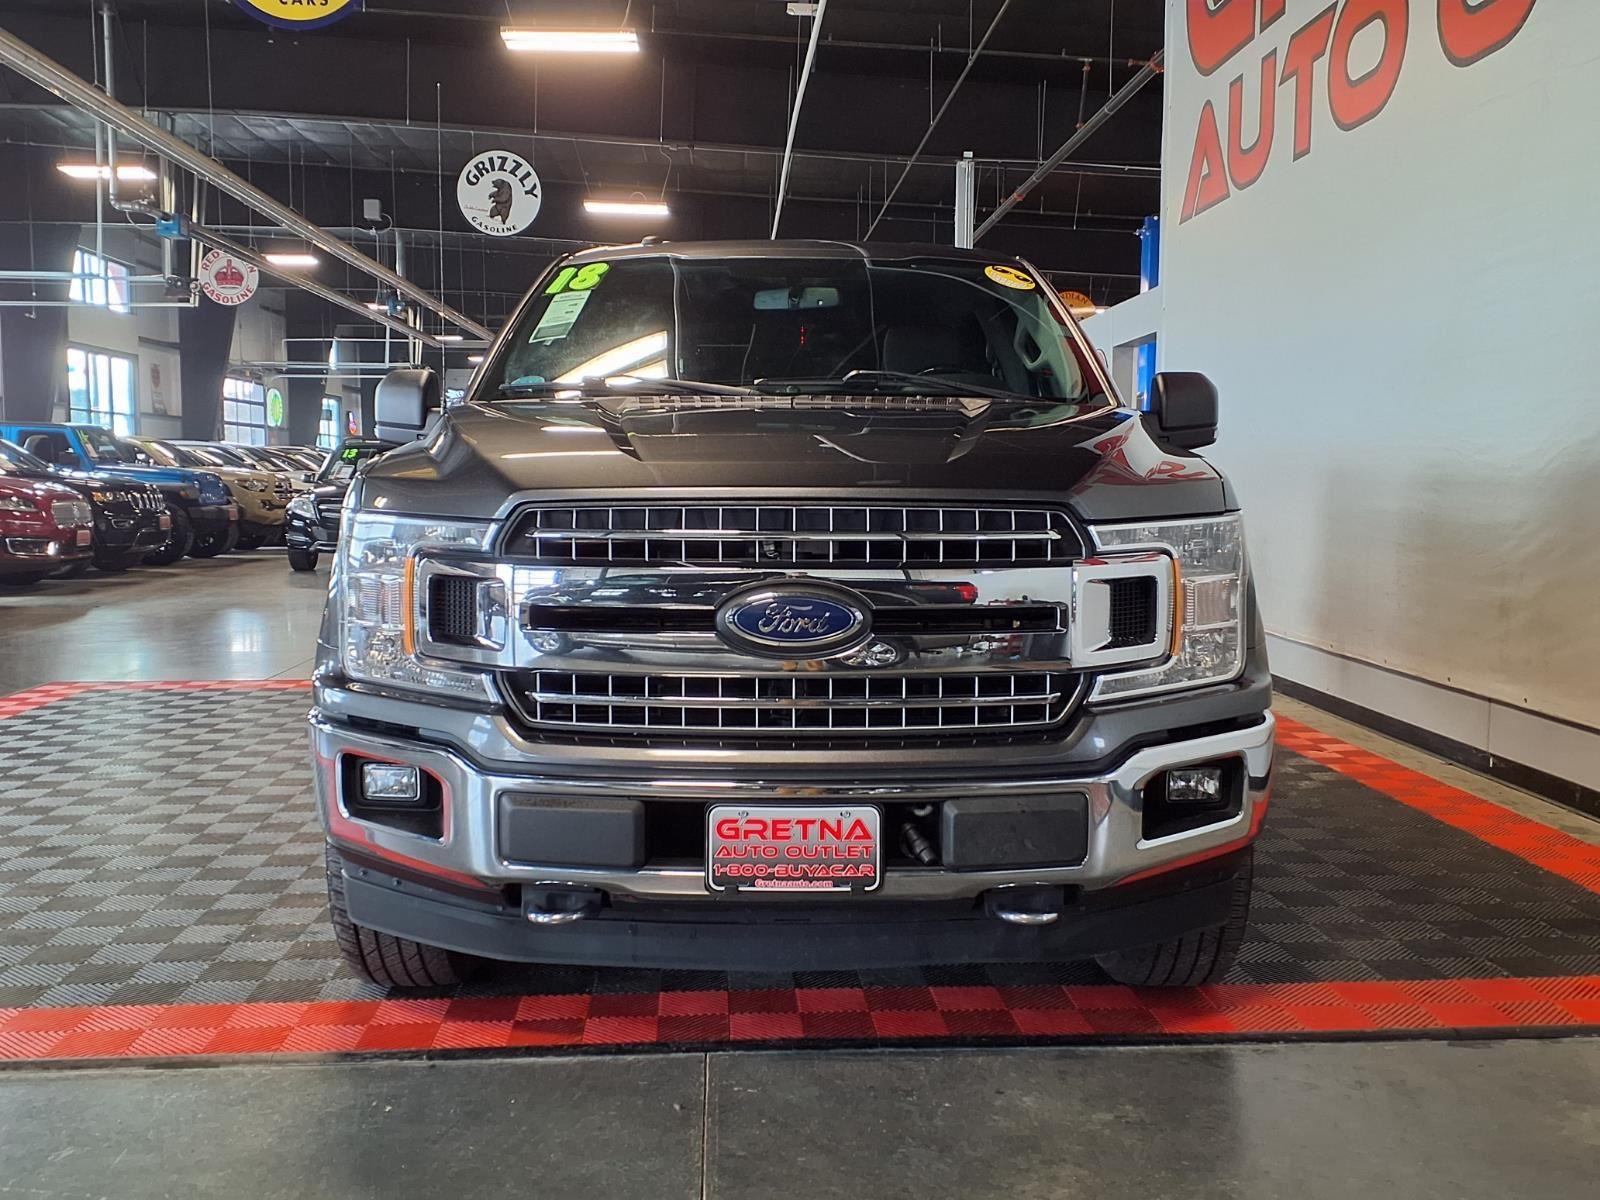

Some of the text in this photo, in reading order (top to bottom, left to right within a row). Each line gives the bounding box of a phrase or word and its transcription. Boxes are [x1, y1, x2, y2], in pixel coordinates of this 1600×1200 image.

[1179, 0, 1410, 226] AUTO
[465, 155, 539, 199] GRIZZLY
[471, 215, 518, 234] GASOLINE
[202, 251, 219, 270] RED
[545, 262, 610, 294] 18
[202, 283, 254, 304] GASOLINE
[342, 448, 359, 459] 13
[758, 602, 831, 634] Ford
[715, 817, 874, 842] GRETNA
[714, 845, 875, 859] AUTO OUTLET
[714, 863, 875, 878] 1-800-BUYACAR
